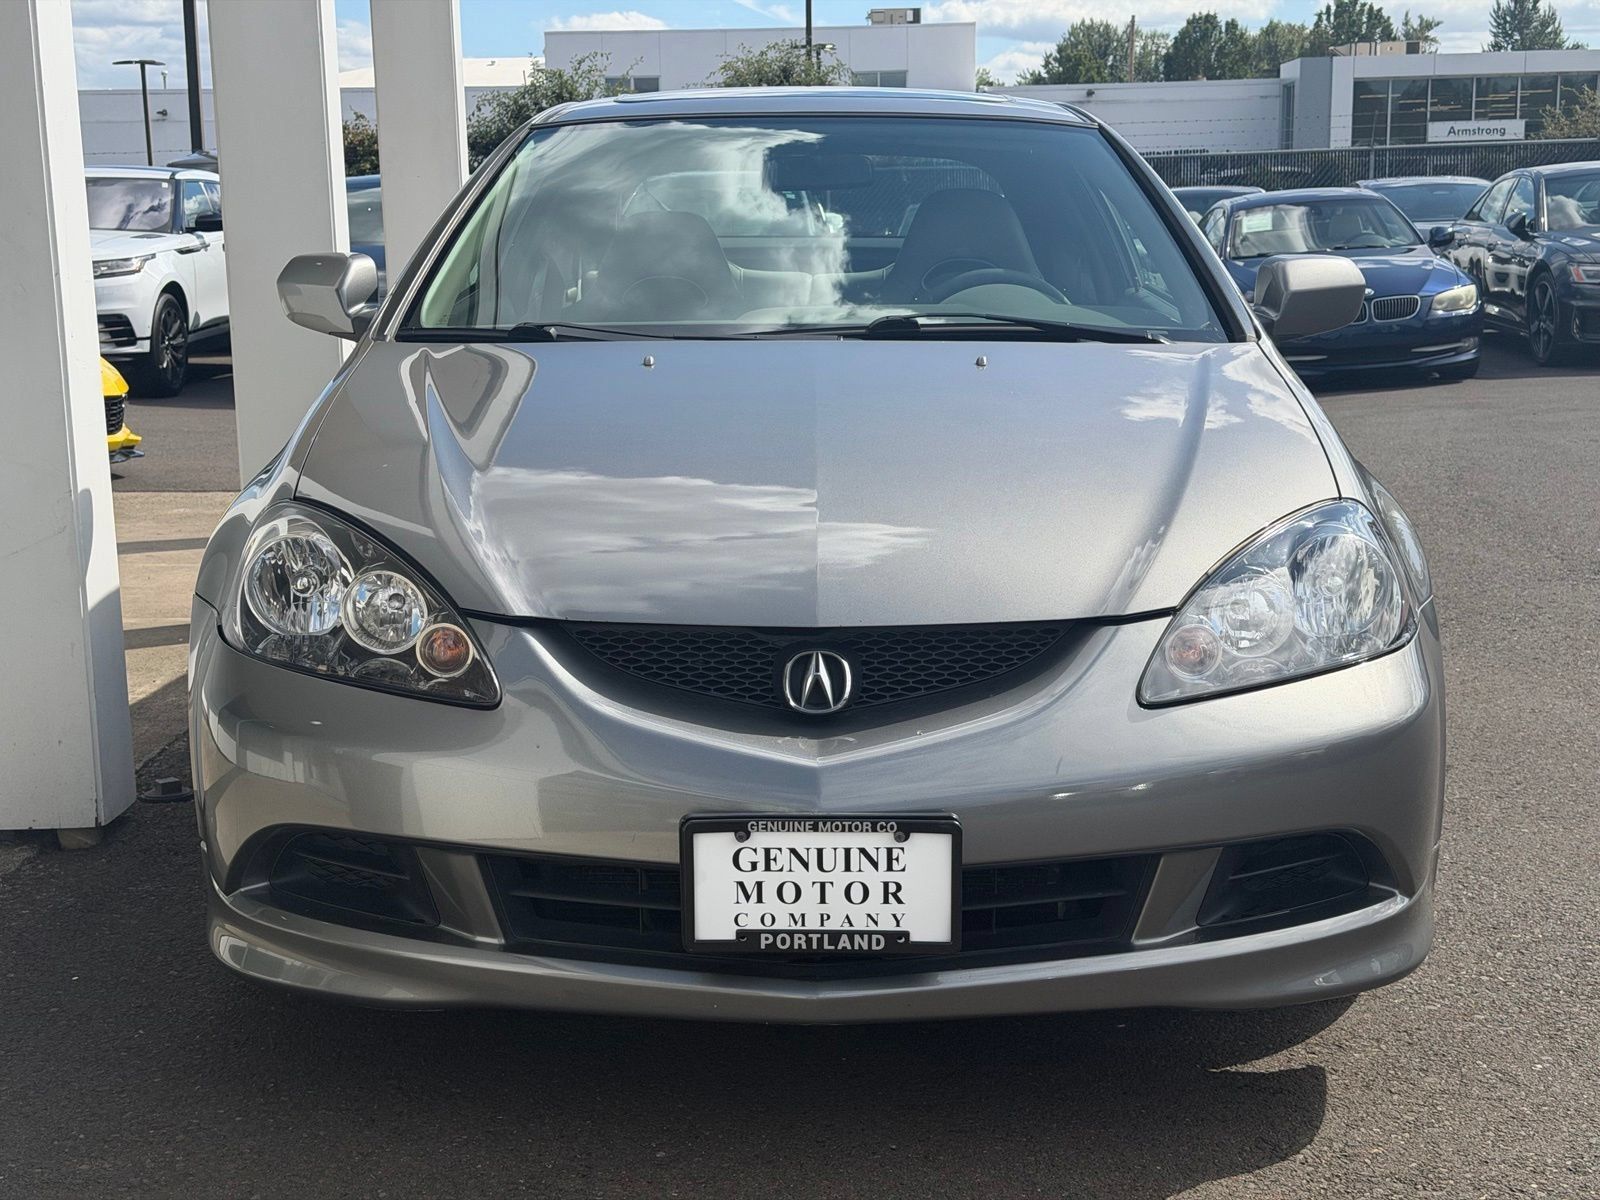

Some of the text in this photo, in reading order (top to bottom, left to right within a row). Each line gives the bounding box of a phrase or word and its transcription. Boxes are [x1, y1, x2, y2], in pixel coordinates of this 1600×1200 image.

[1447, 126, 1506, 137] Armstrong
[747, 821, 898, 833] GENUINE MOTOR CO
[732, 846, 906, 873] GENUINE
[733, 880, 906, 905] MOTOR
[733, 912, 906, 928] COMPANY
[760, 933, 886, 950] PORTLAND
